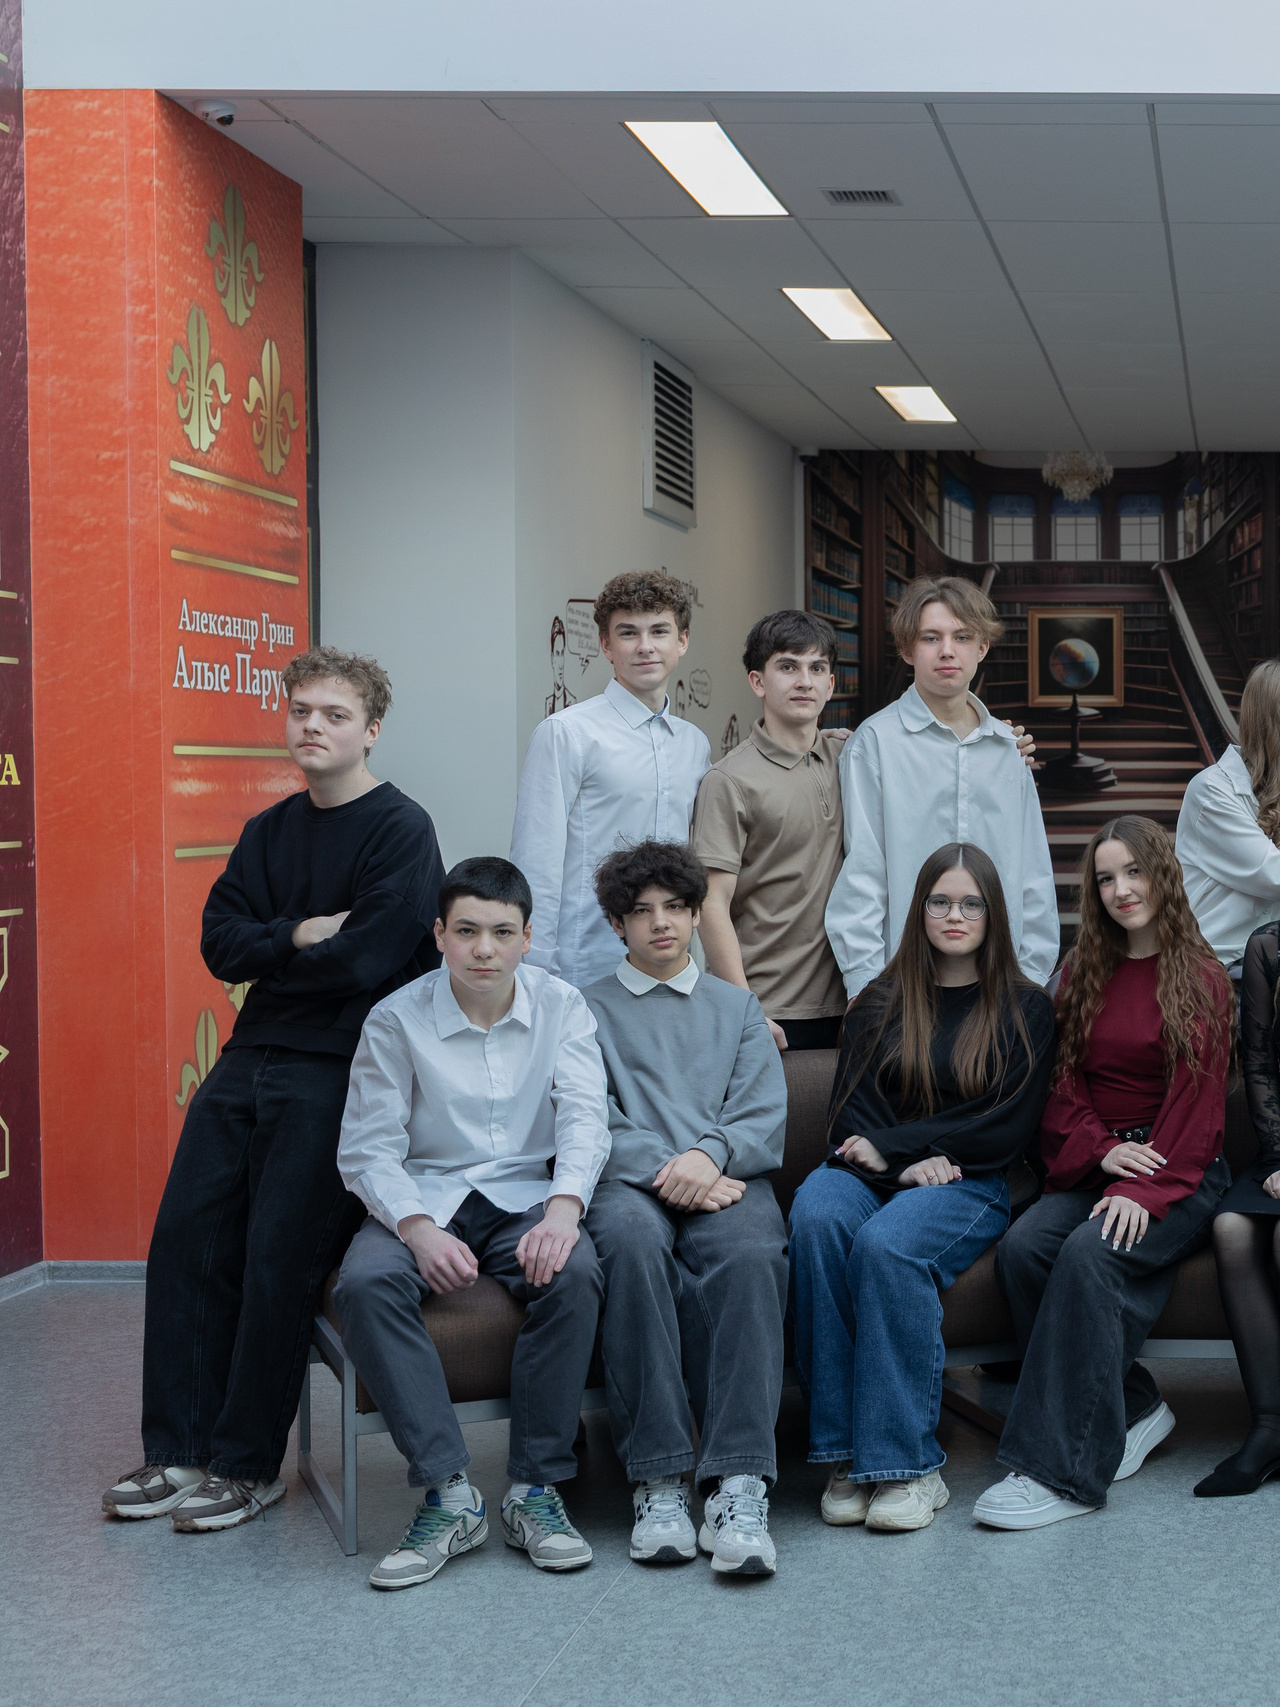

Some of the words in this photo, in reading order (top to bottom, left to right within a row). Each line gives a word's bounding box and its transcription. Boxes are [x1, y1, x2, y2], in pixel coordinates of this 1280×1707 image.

[177, 598, 259, 651] Александр
[261, 612, 295, 653] Грин
[172, 645, 230, 693] Алые
[0, 753, 21, 786] А
